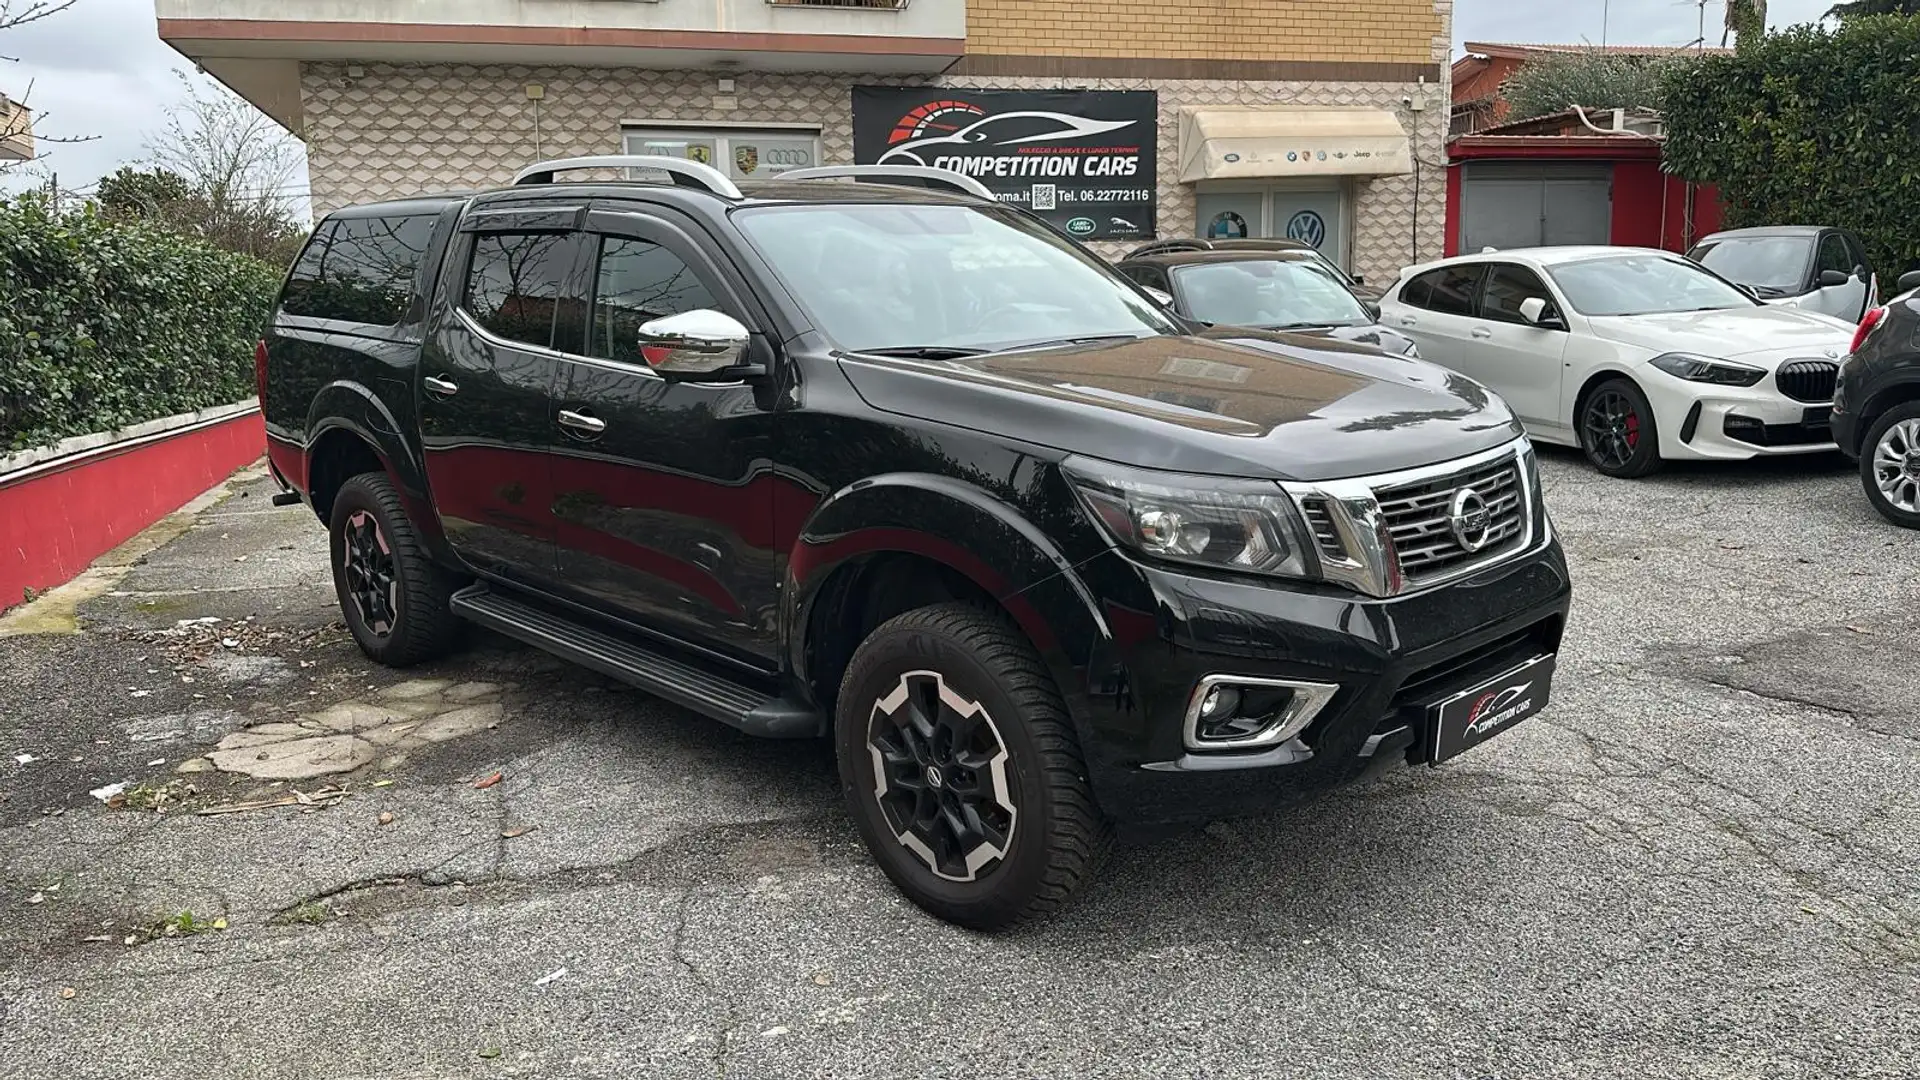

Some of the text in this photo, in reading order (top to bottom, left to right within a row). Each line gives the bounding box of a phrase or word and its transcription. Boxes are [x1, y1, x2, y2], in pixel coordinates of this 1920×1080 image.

[934, 156, 1139, 177] COMPETITION CARS
[1057, 190, 1078, 201] Tel.
[1080, 190, 1149, 202] 06.22772116
